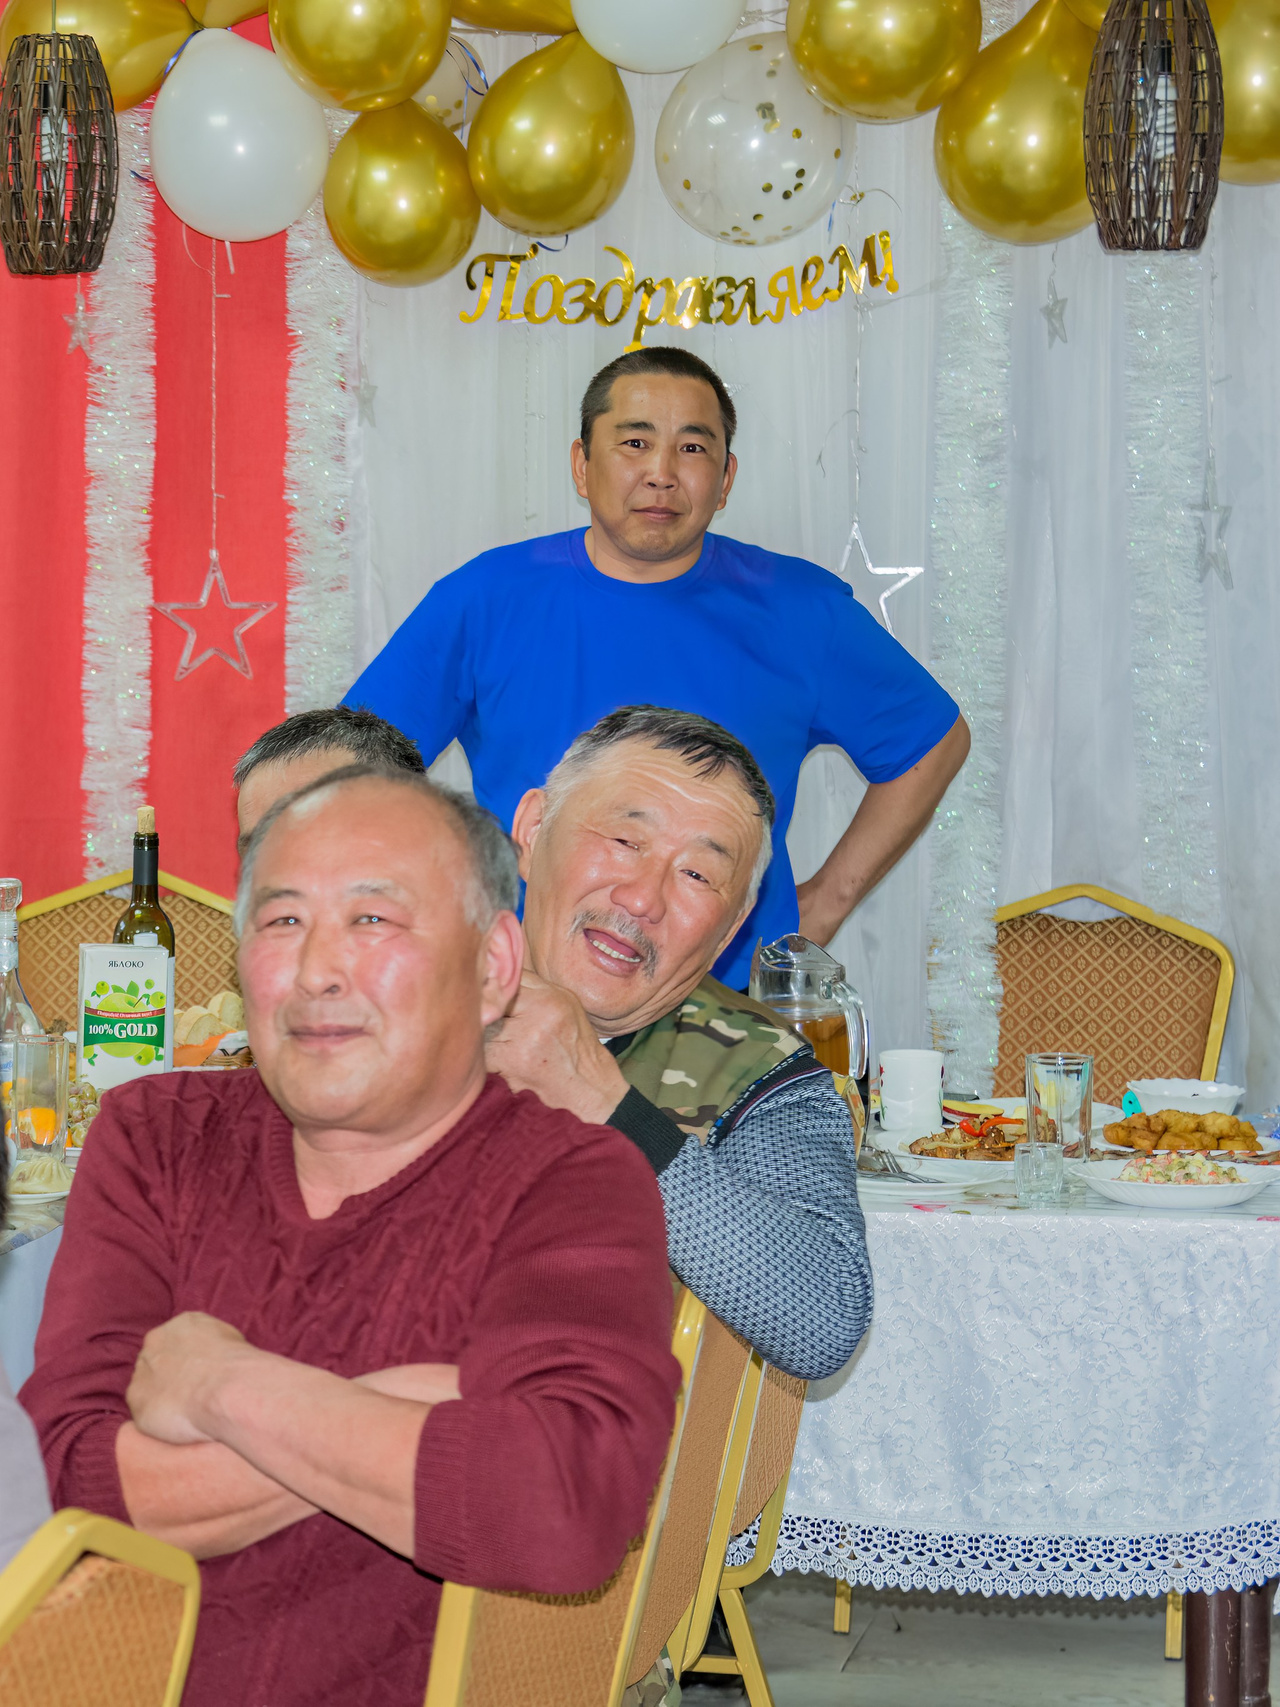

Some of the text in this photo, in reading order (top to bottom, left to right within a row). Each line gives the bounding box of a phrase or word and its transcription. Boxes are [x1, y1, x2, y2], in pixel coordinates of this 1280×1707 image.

[458, 230, 900, 353] Поздравляем!
[108, 960, 145, 968] ЯБЛОКО
[88, 1022, 158, 1039] 100% GOLD
